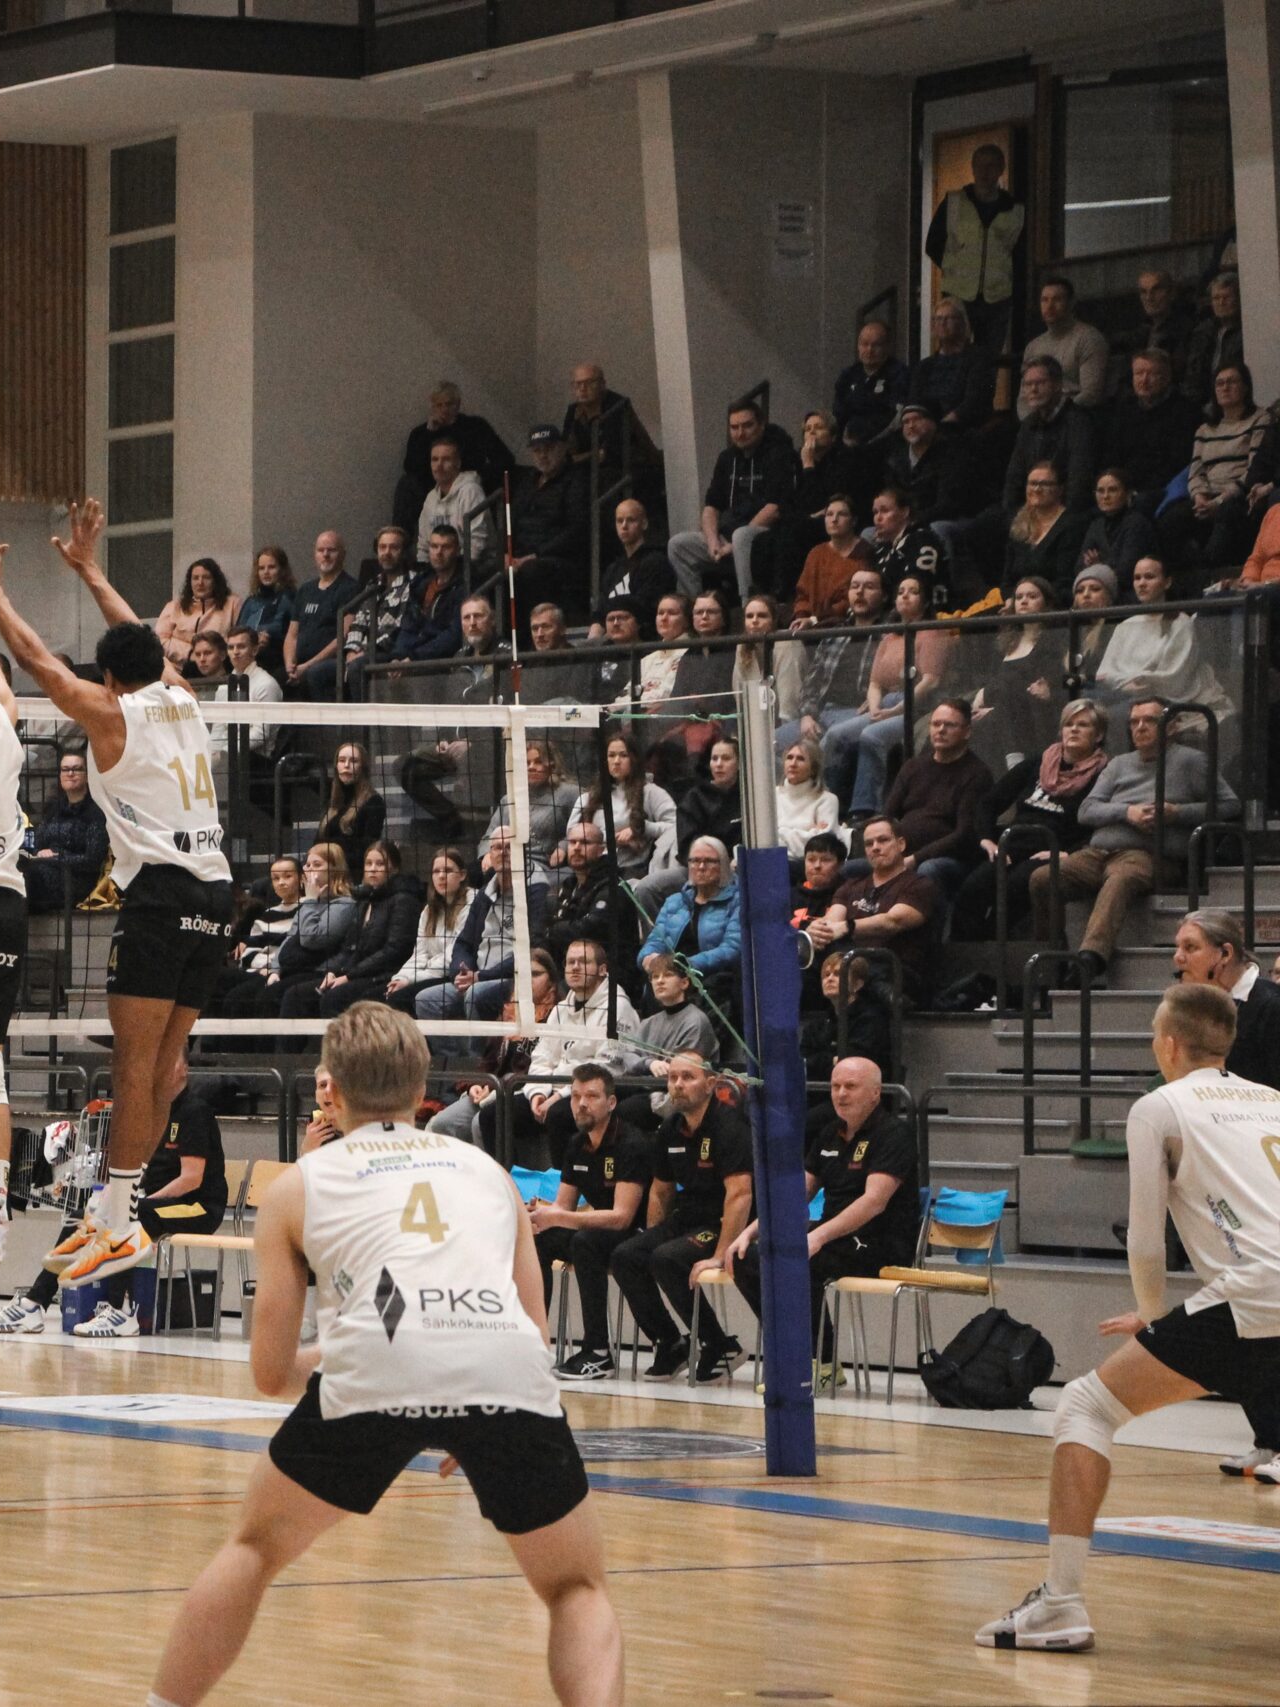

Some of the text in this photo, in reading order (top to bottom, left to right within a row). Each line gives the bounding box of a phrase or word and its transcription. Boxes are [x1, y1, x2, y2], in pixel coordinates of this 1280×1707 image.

[168, 753, 214, 811] 14
[223, 923, 232, 937] O
[345, 1134, 450, 1155] PUHAKKA
[356, 1160, 458, 1181] SAARELAINEN
[399, 1181, 450, 1244] 4
[419, 1288, 504, 1315] PKS
[422, 1317, 519, 1332] Sähkökauppa
